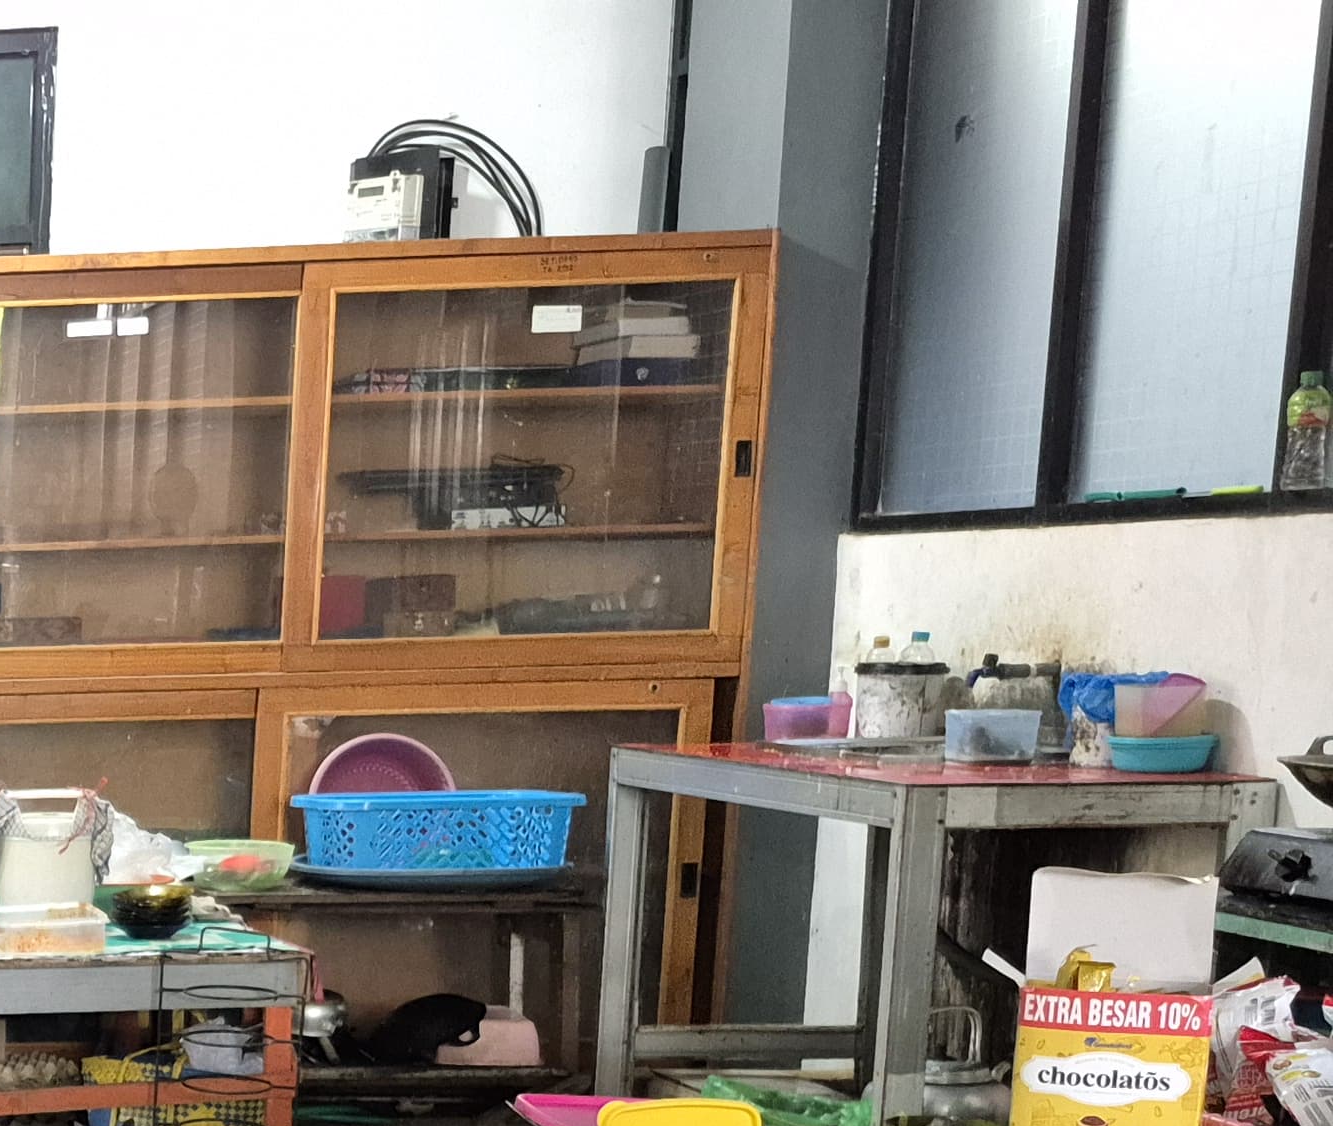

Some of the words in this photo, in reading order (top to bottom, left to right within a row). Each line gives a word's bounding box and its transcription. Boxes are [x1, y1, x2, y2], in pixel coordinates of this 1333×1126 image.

[1023, 994, 1083, 1026] EXTRA
[1087, 998, 1152, 1030] BESAR
[1157, 1002, 1201, 1031] 10%
